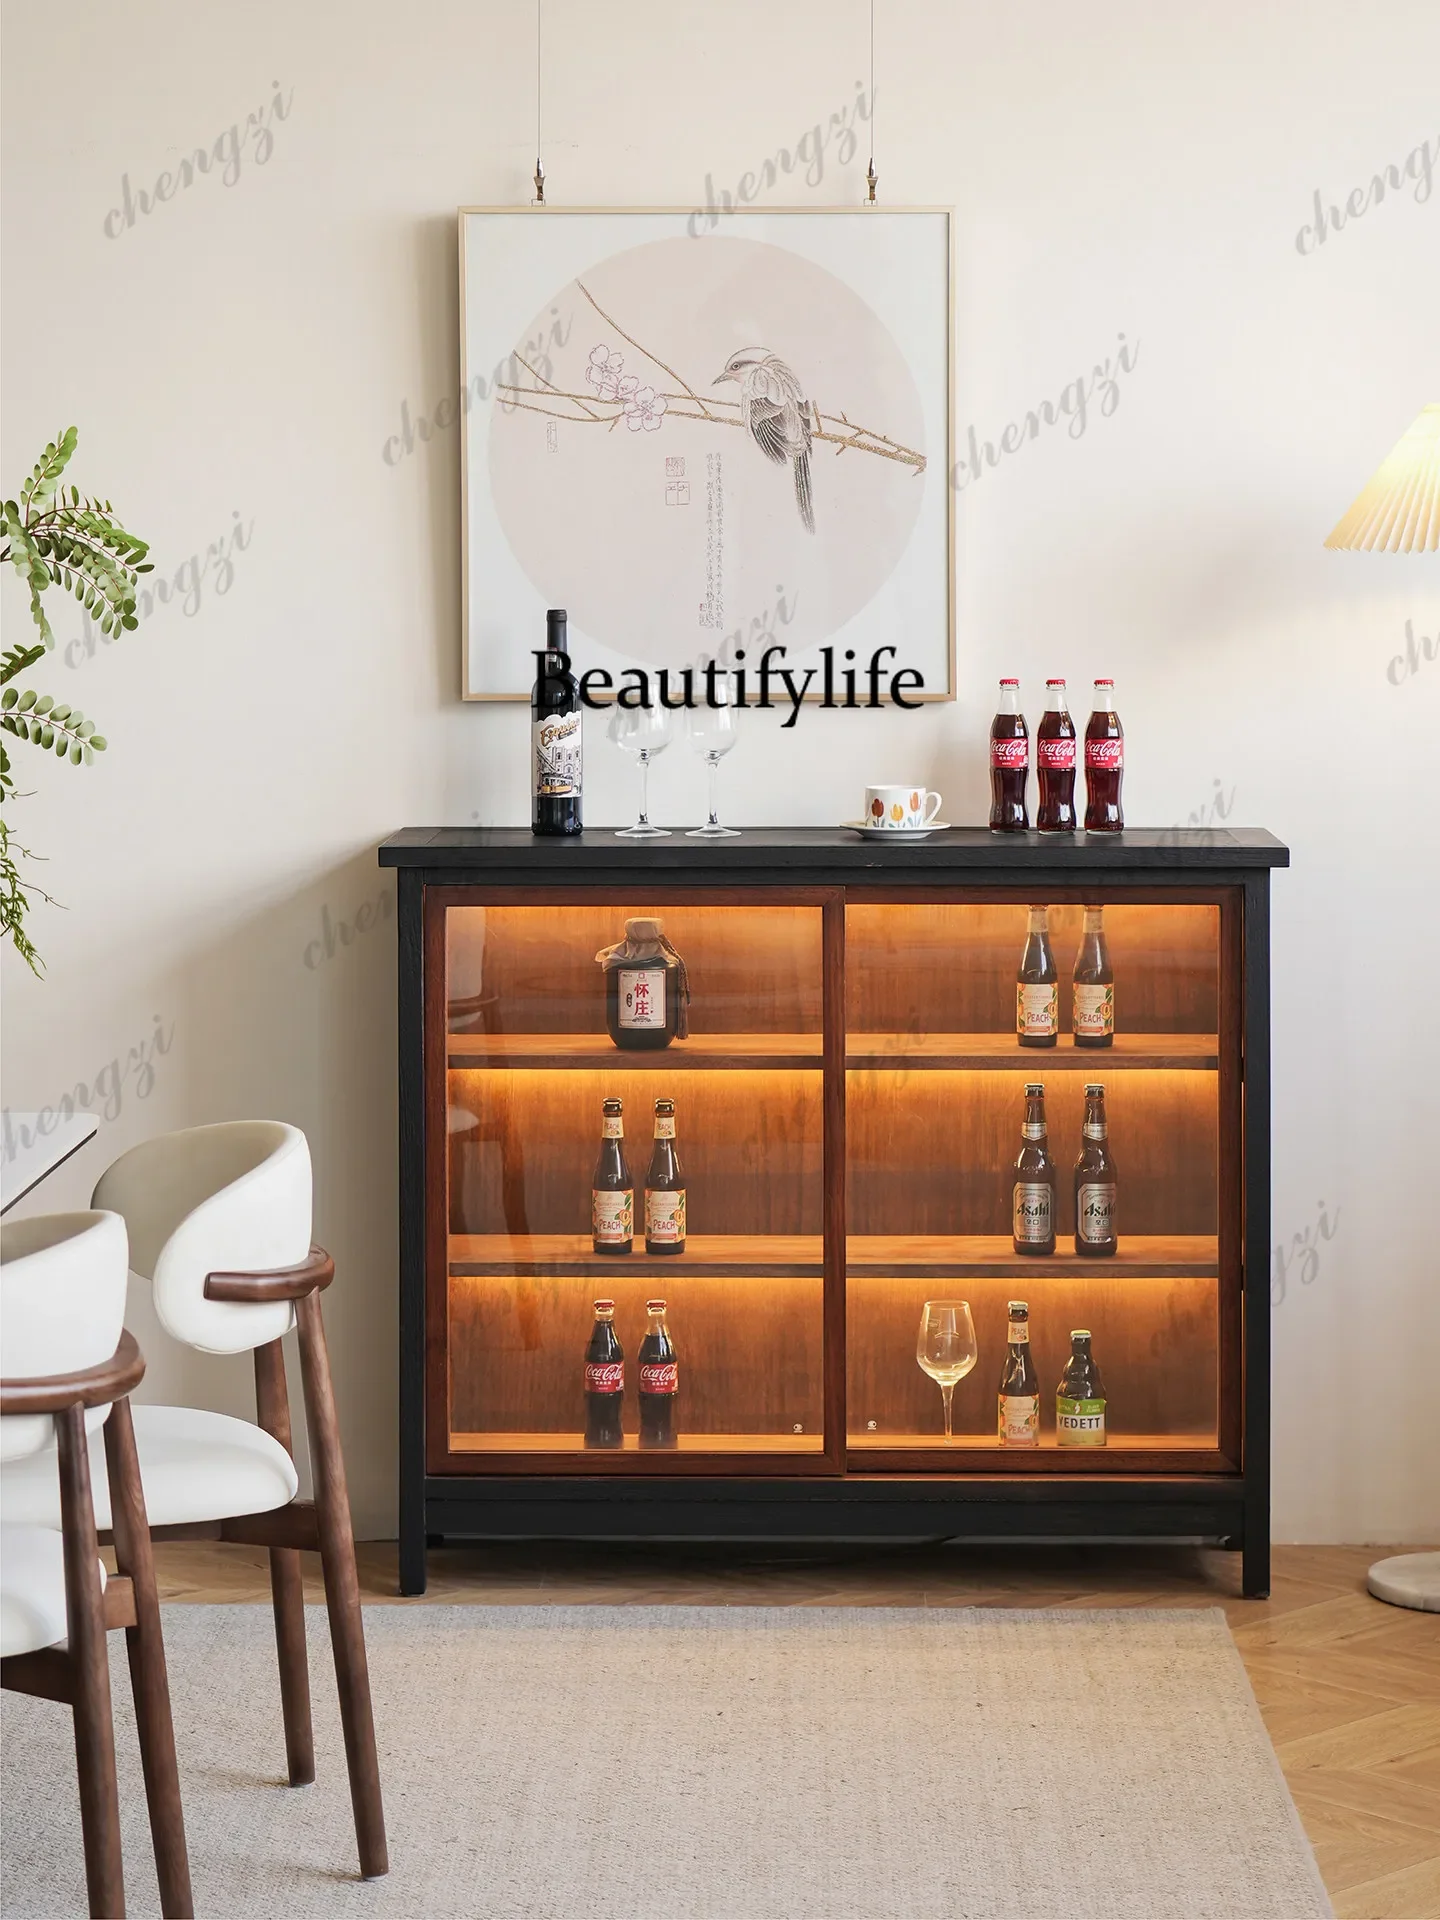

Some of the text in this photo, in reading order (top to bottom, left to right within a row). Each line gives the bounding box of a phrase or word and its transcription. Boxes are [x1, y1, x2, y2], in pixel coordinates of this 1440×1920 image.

[634, 982, 649, 1016] 怀庄
[1026, 1011, 1050, 1024] PEACH
[1079, 1011, 1102, 1024] PEACH
[1016, 1200, 1050, 1217] Asahi
[598, 1218, 621, 1231] PEACH
[653, 1218, 676, 1231] PEACH
[1058, 1415, 1101, 1429] VEDETT
